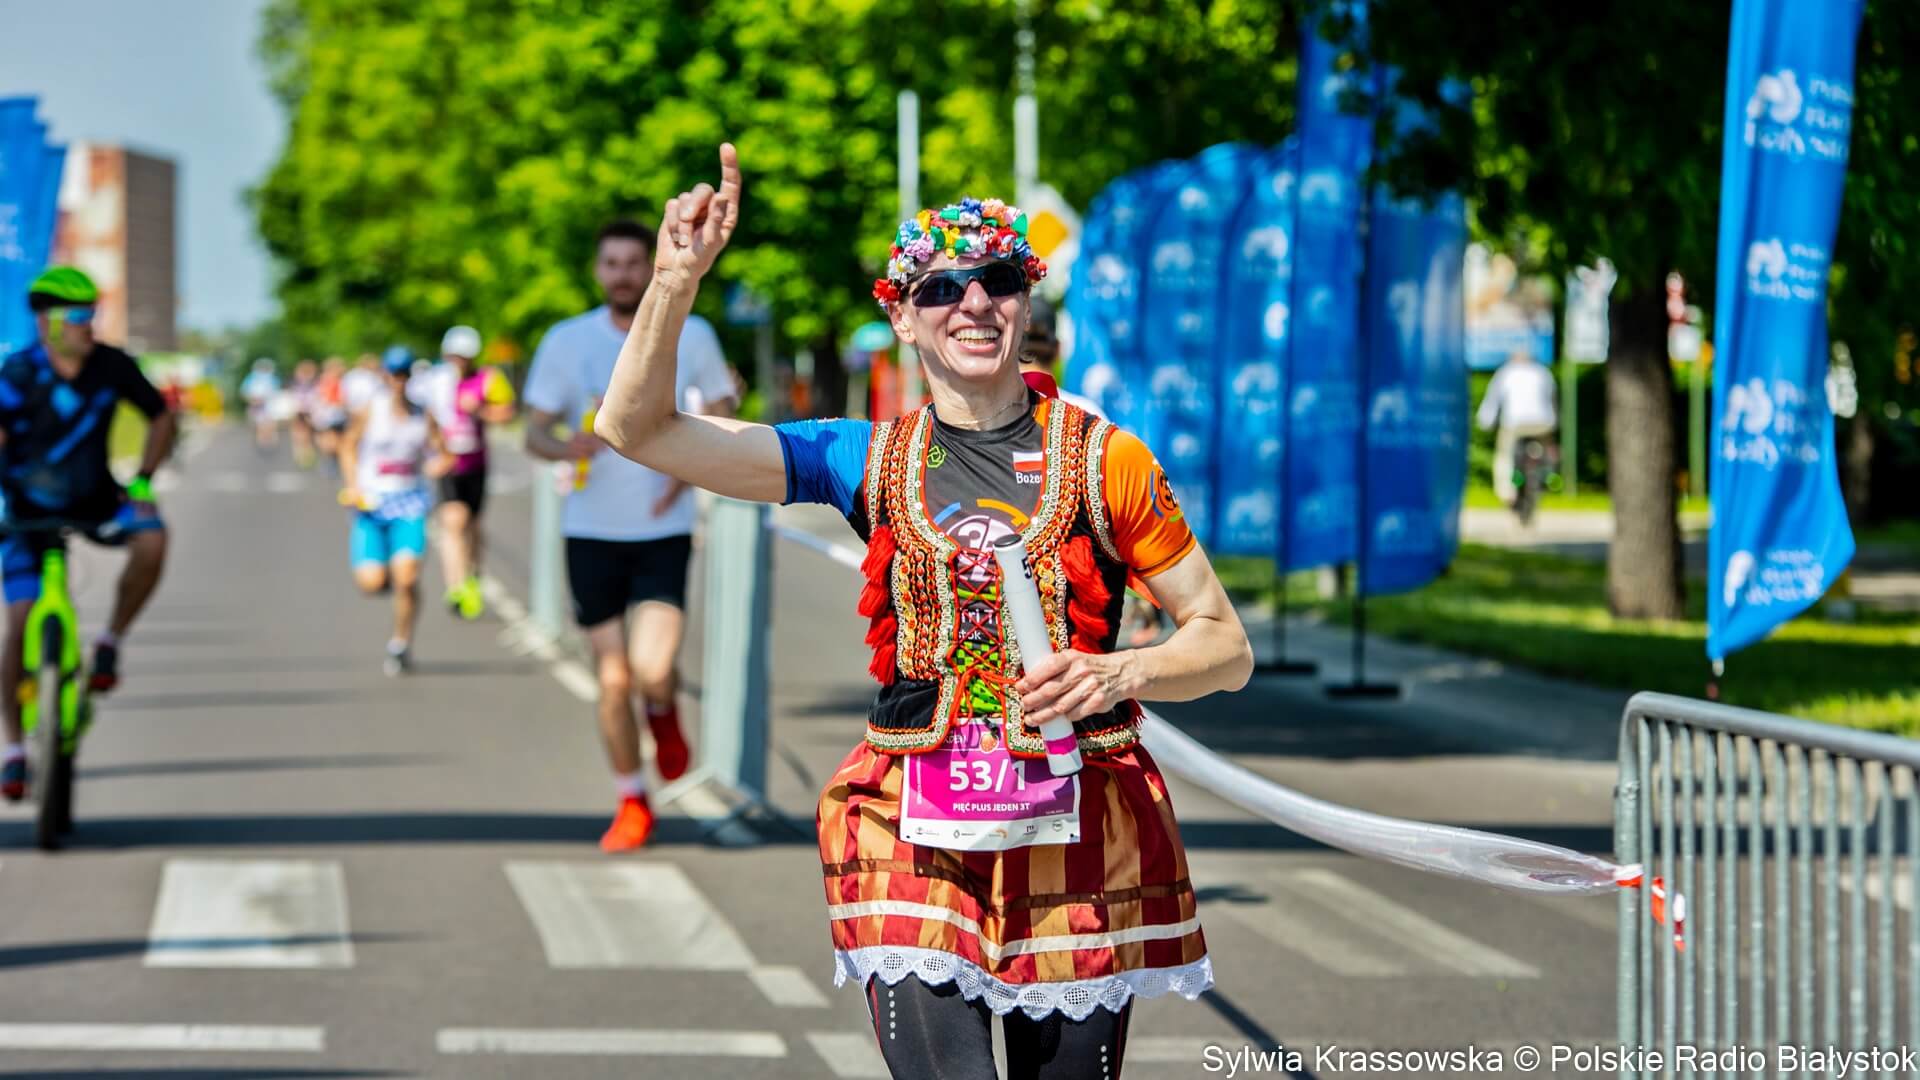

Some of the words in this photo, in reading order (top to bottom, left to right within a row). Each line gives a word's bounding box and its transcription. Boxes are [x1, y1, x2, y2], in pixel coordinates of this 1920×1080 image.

[949, 758, 1026, 793] 53/1
[953, 802, 970, 813] PIĘĆ
[971, 802, 992, 812] PLUS
[992, 802, 1019, 812] JEDEN
[1019, 802, 1031, 811] 3T
